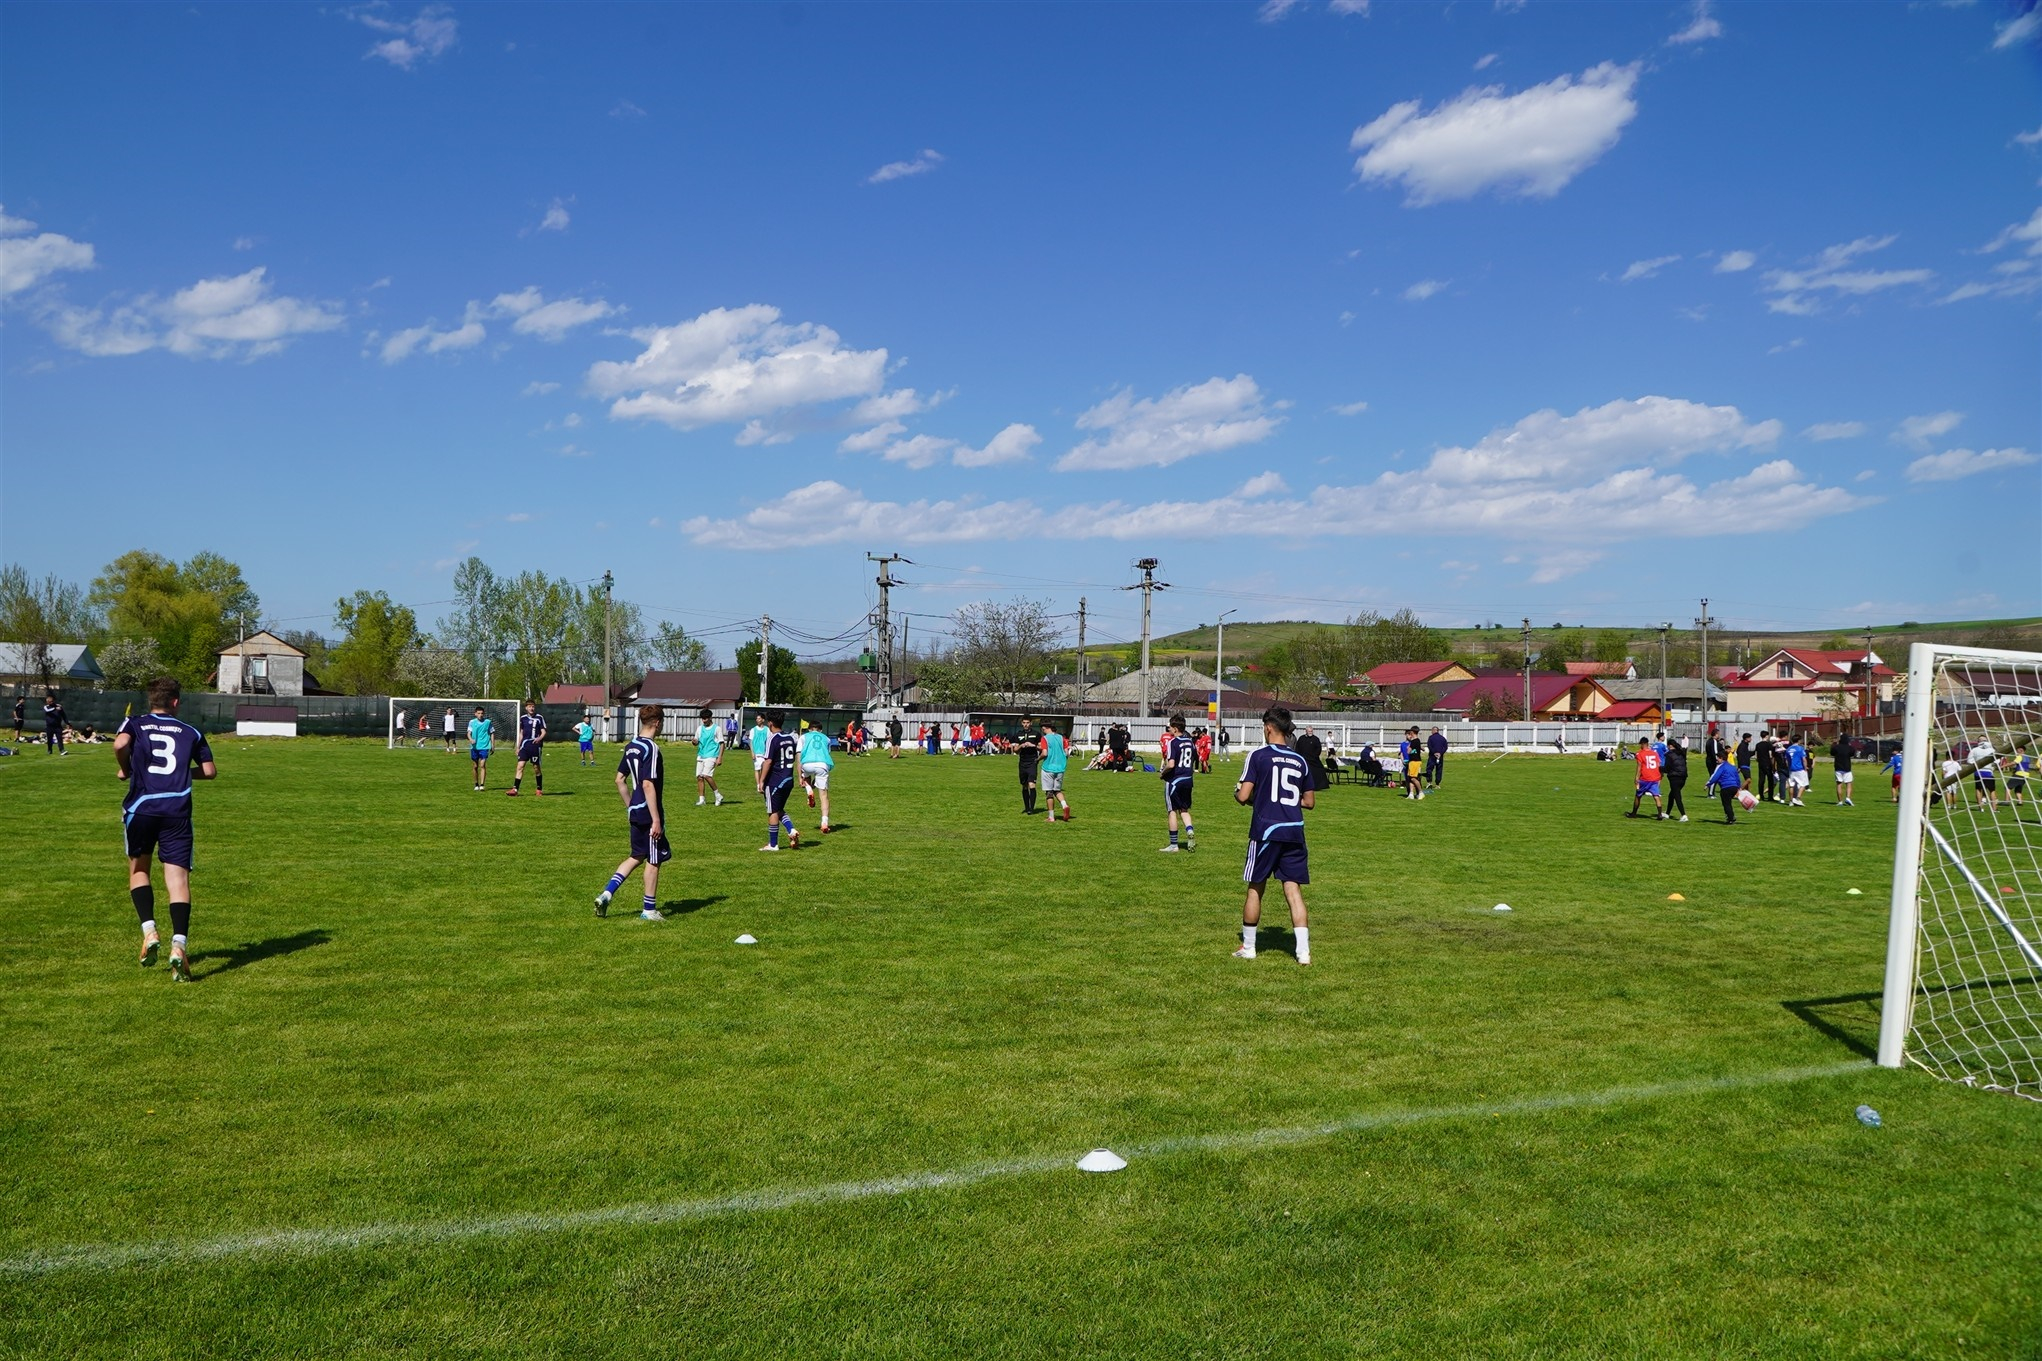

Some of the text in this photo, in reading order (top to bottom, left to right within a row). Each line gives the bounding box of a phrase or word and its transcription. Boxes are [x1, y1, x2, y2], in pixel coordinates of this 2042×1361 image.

[812, 734, 823, 750] 8
[147, 733, 177, 775] 3
[780, 746, 794, 769] 19
[1178, 747, 1192, 768] 18
[1271, 765, 1302, 807] 15
